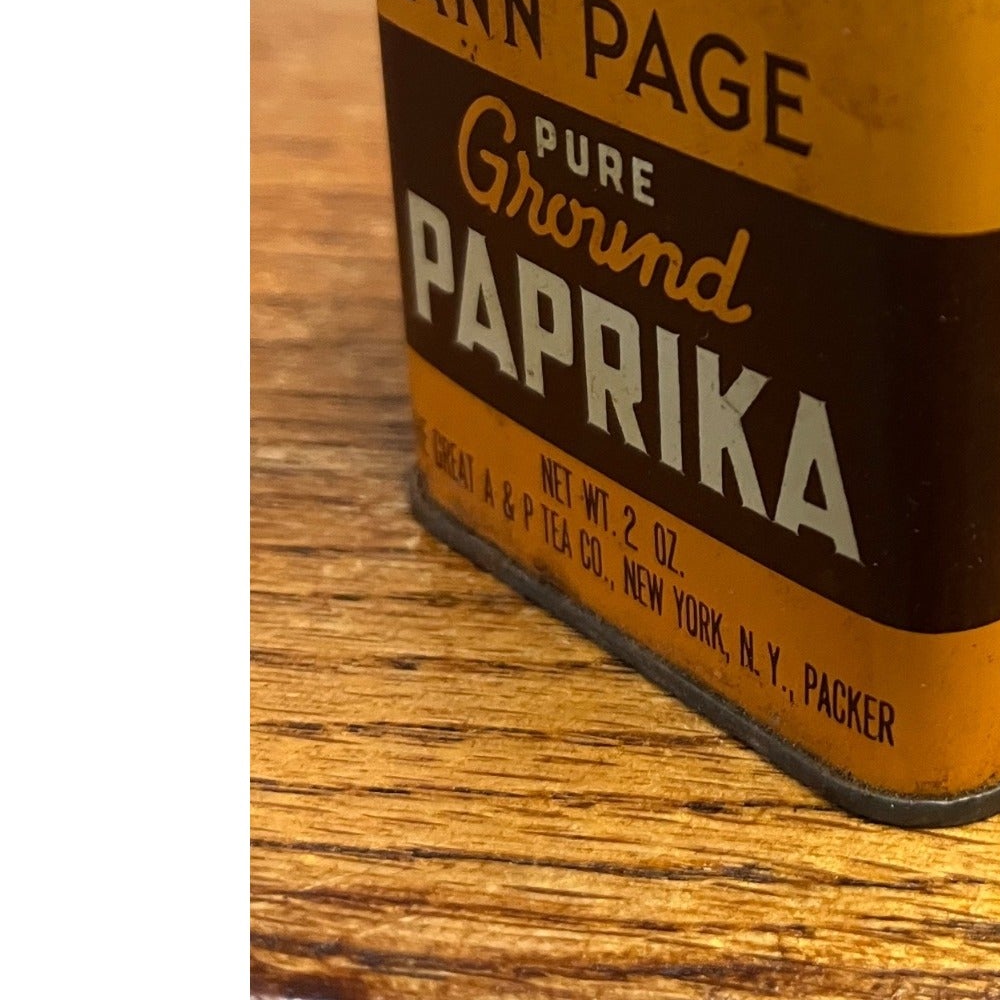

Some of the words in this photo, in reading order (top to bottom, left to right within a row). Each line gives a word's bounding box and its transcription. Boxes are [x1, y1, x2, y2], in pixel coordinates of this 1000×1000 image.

[458, 95, 752, 323] Ground
[535, 116, 654, 206] PURE
[407, 188, 865, 567] PAPRIKA
[432, 429, 474, 493] GREAT
[484, 468, 495, 508] A
[503, 480, 515, 521] &
[523, 493, 534, 530] P
[541, 504, 572, 559] TEA
[624, 558, 664, 616] NEW
[673, 585, 729, 663] YORK,
[804, 663, 896, 746] PACKER
[540, 454, 573, 508] NET
[583, 480, 616, 536] WT.
[624, 505, 638, 550] 2
[654, 523, 685, 577] OZ.
